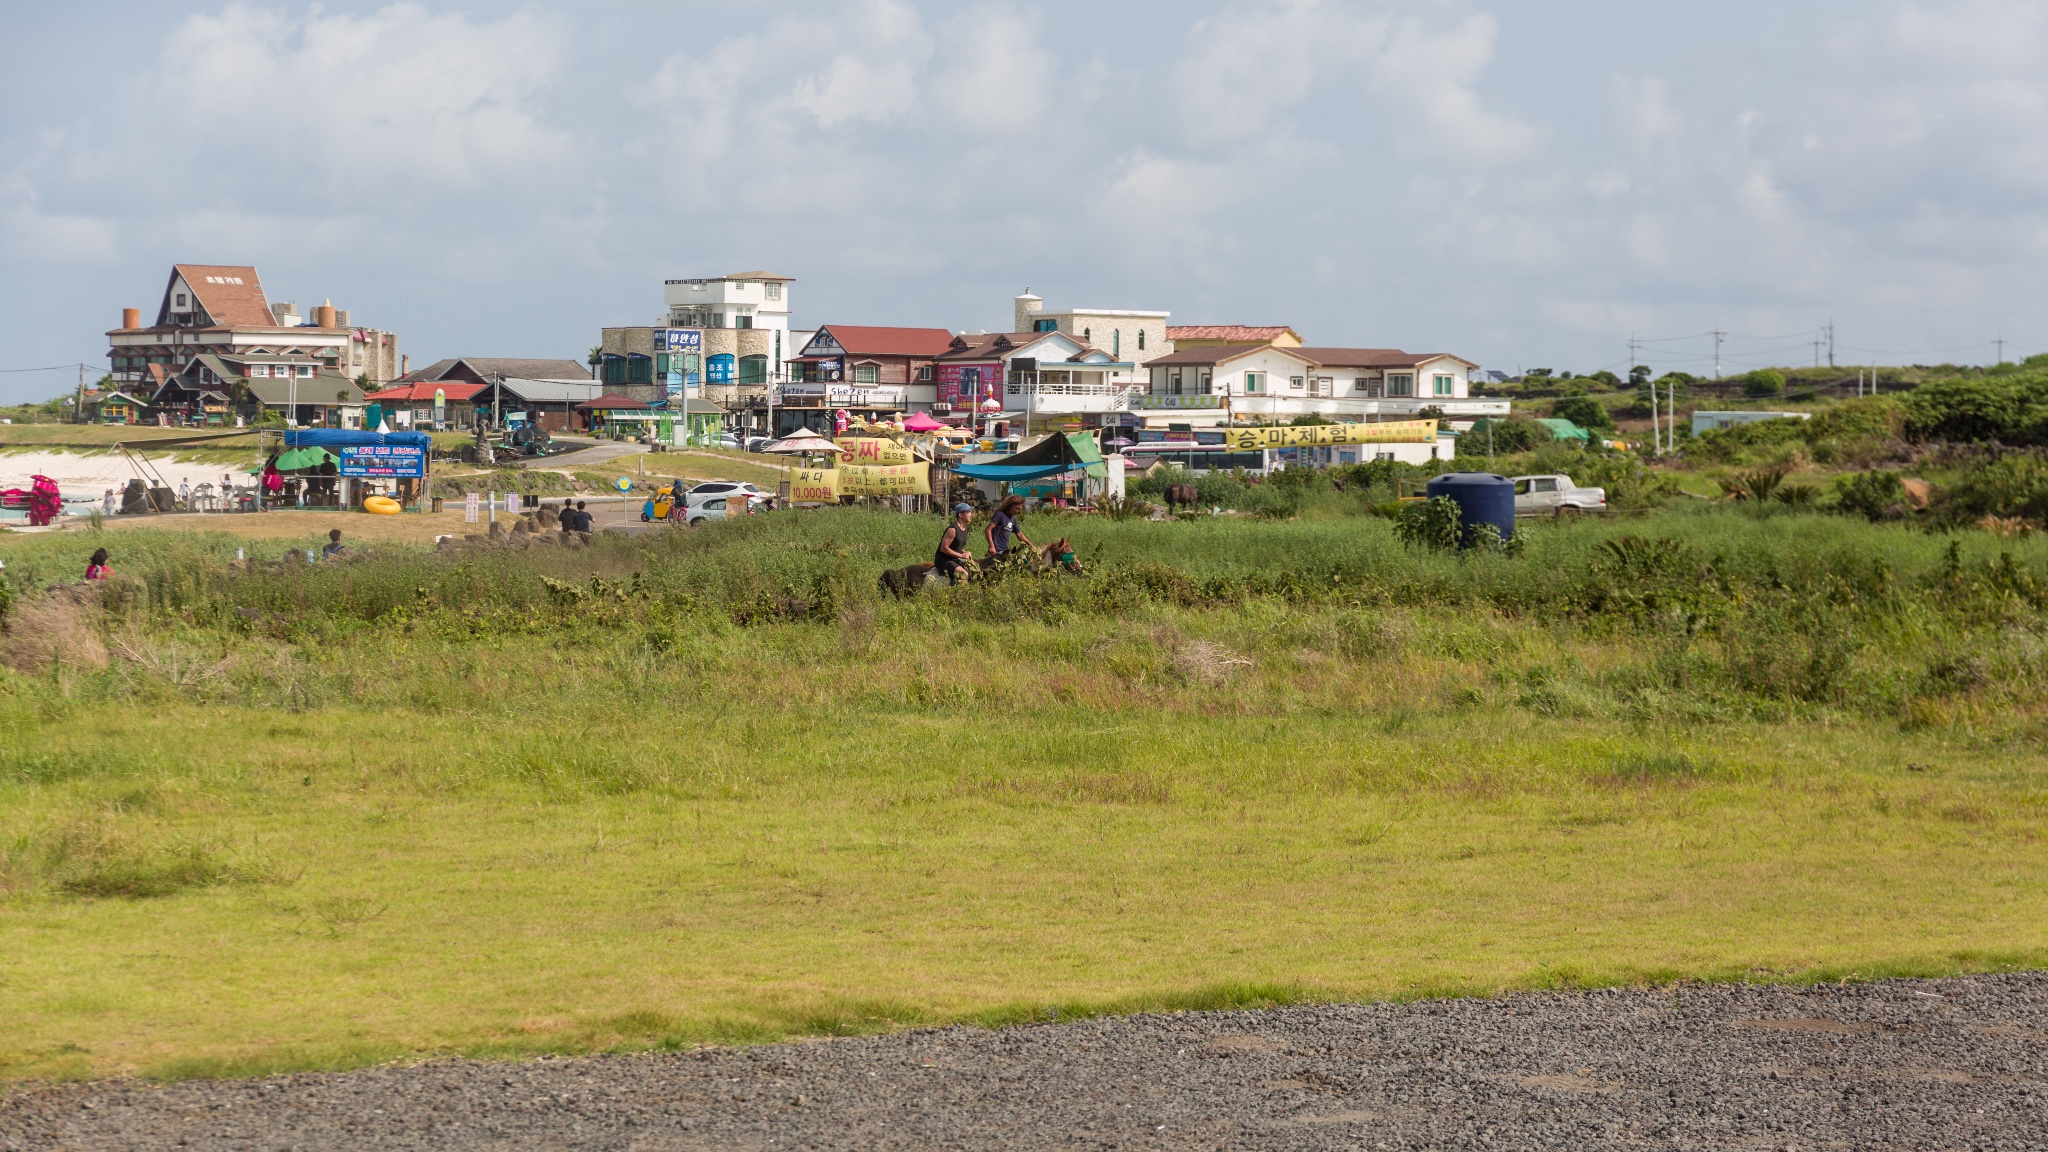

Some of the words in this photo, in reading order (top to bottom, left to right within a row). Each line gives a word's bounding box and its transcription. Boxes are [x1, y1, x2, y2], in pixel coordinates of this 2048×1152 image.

[1238, 425, 1347, 449] 승마체험
[840, 440, 880, 463] 공짜
[883, 451, 907, 461] 없으면
[800, 471, 823, 483] 싸다
[793, 486, 832, 499] 10,000원
